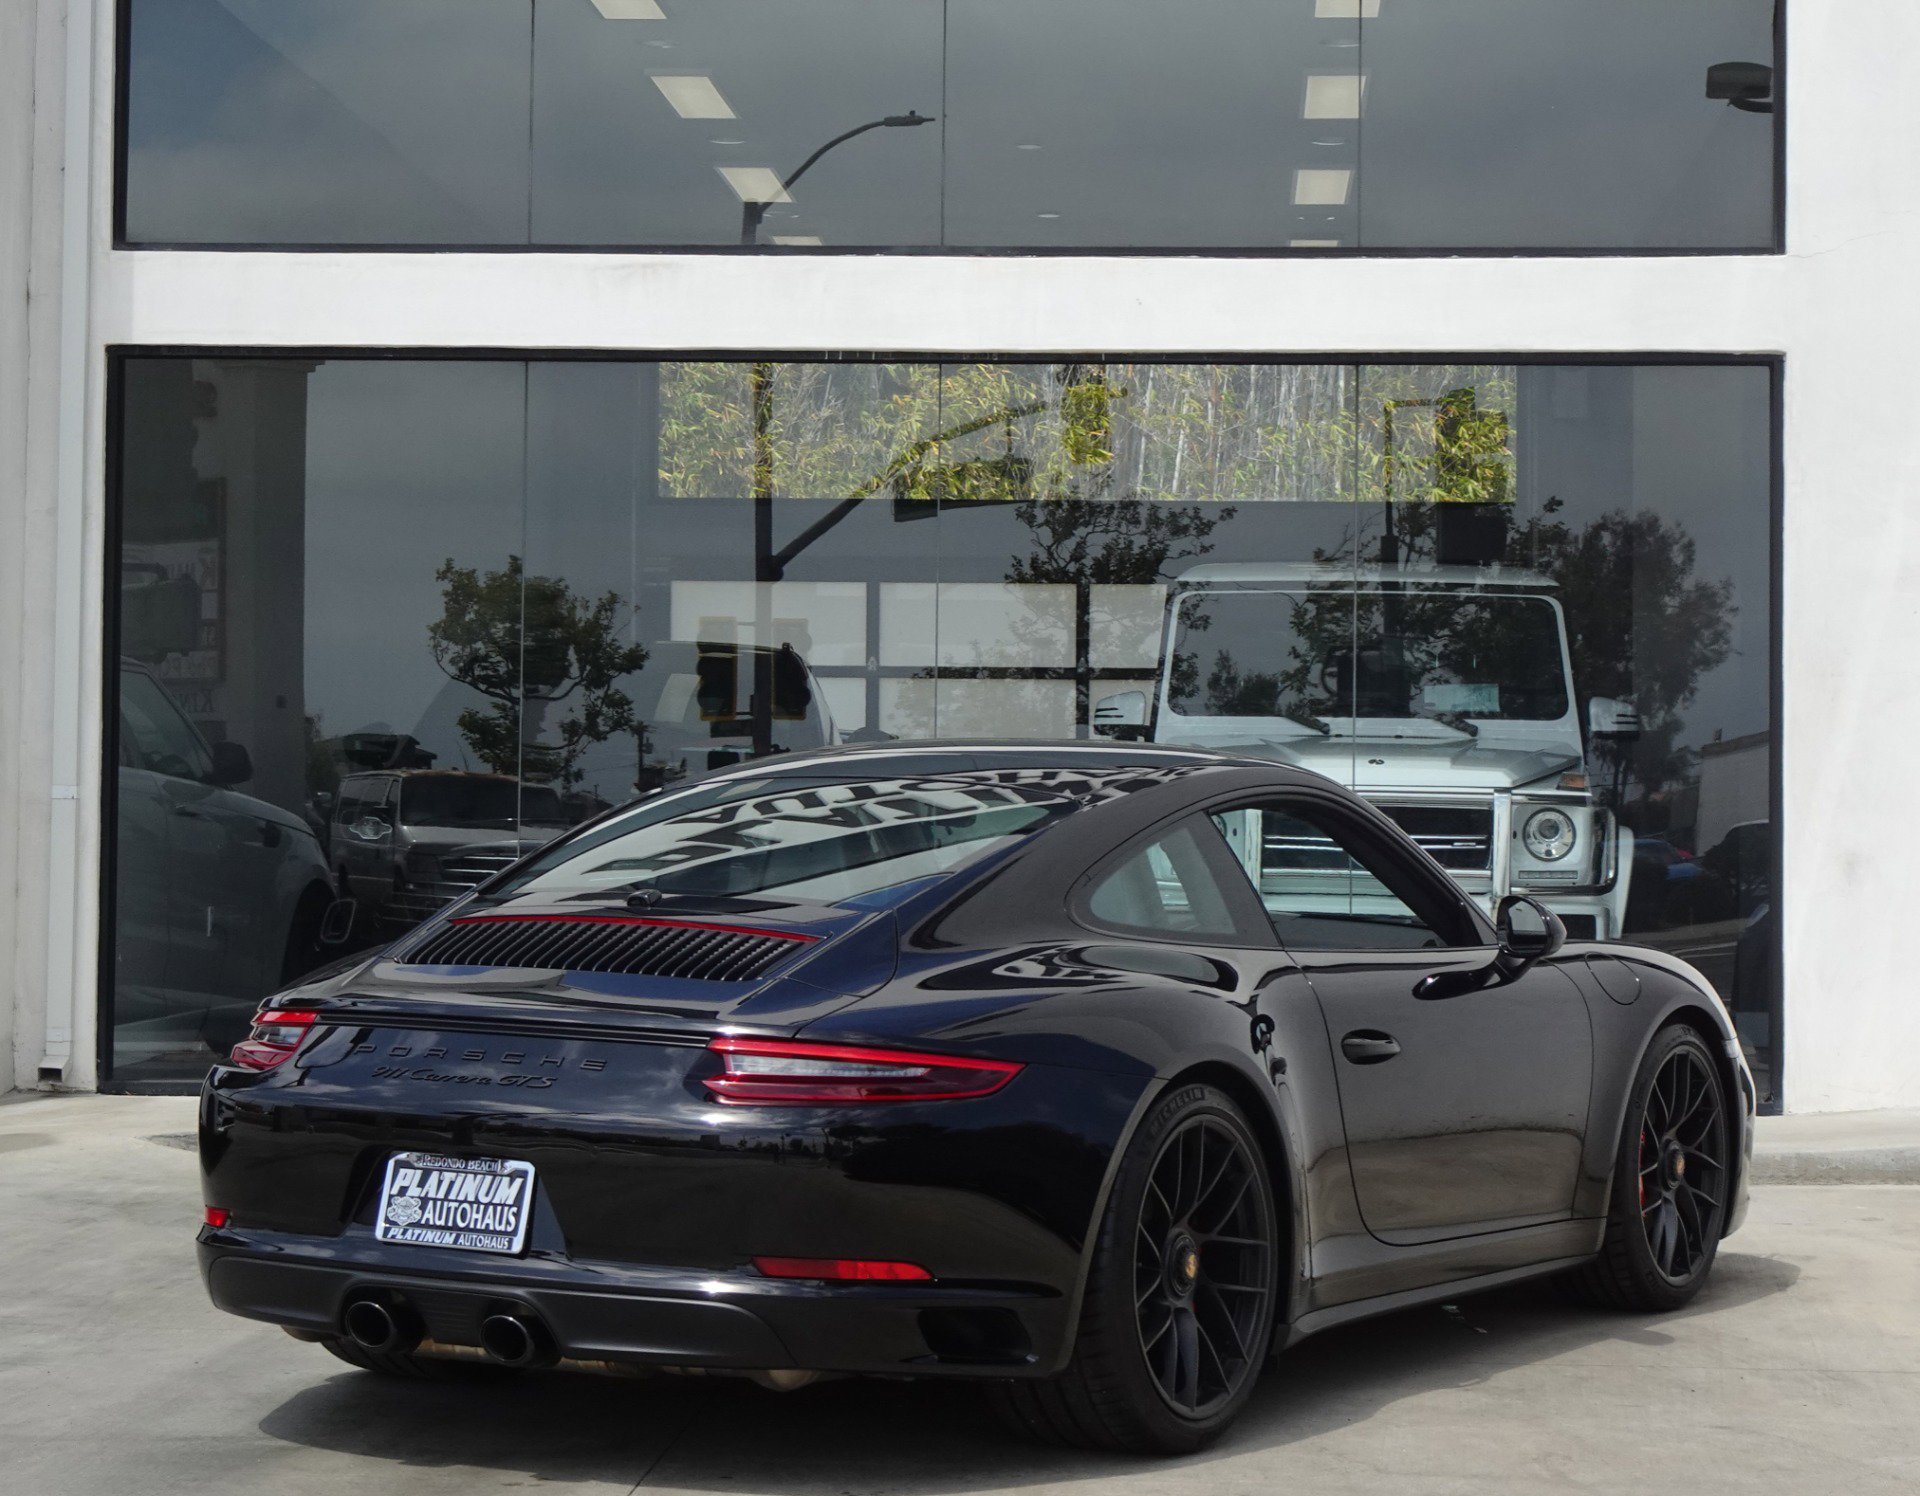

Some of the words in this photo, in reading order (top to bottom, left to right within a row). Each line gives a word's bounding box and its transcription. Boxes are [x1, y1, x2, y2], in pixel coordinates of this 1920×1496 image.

[354, 1044, 607, 1071] PORSCHE
[371, 1065, 408, 1079] 911
[410, 1068, 492, 1085] Carrera
[497, 1074, 557, 1088] GTS
[391, 1169, 523, 1204] PLATINUM
[421, 1200, 518, 1232] AUTOHAUS
[388, 1228, 455, 1244] PLATINUM
[458, 1234, 508, 1249] AUTOHAUS
